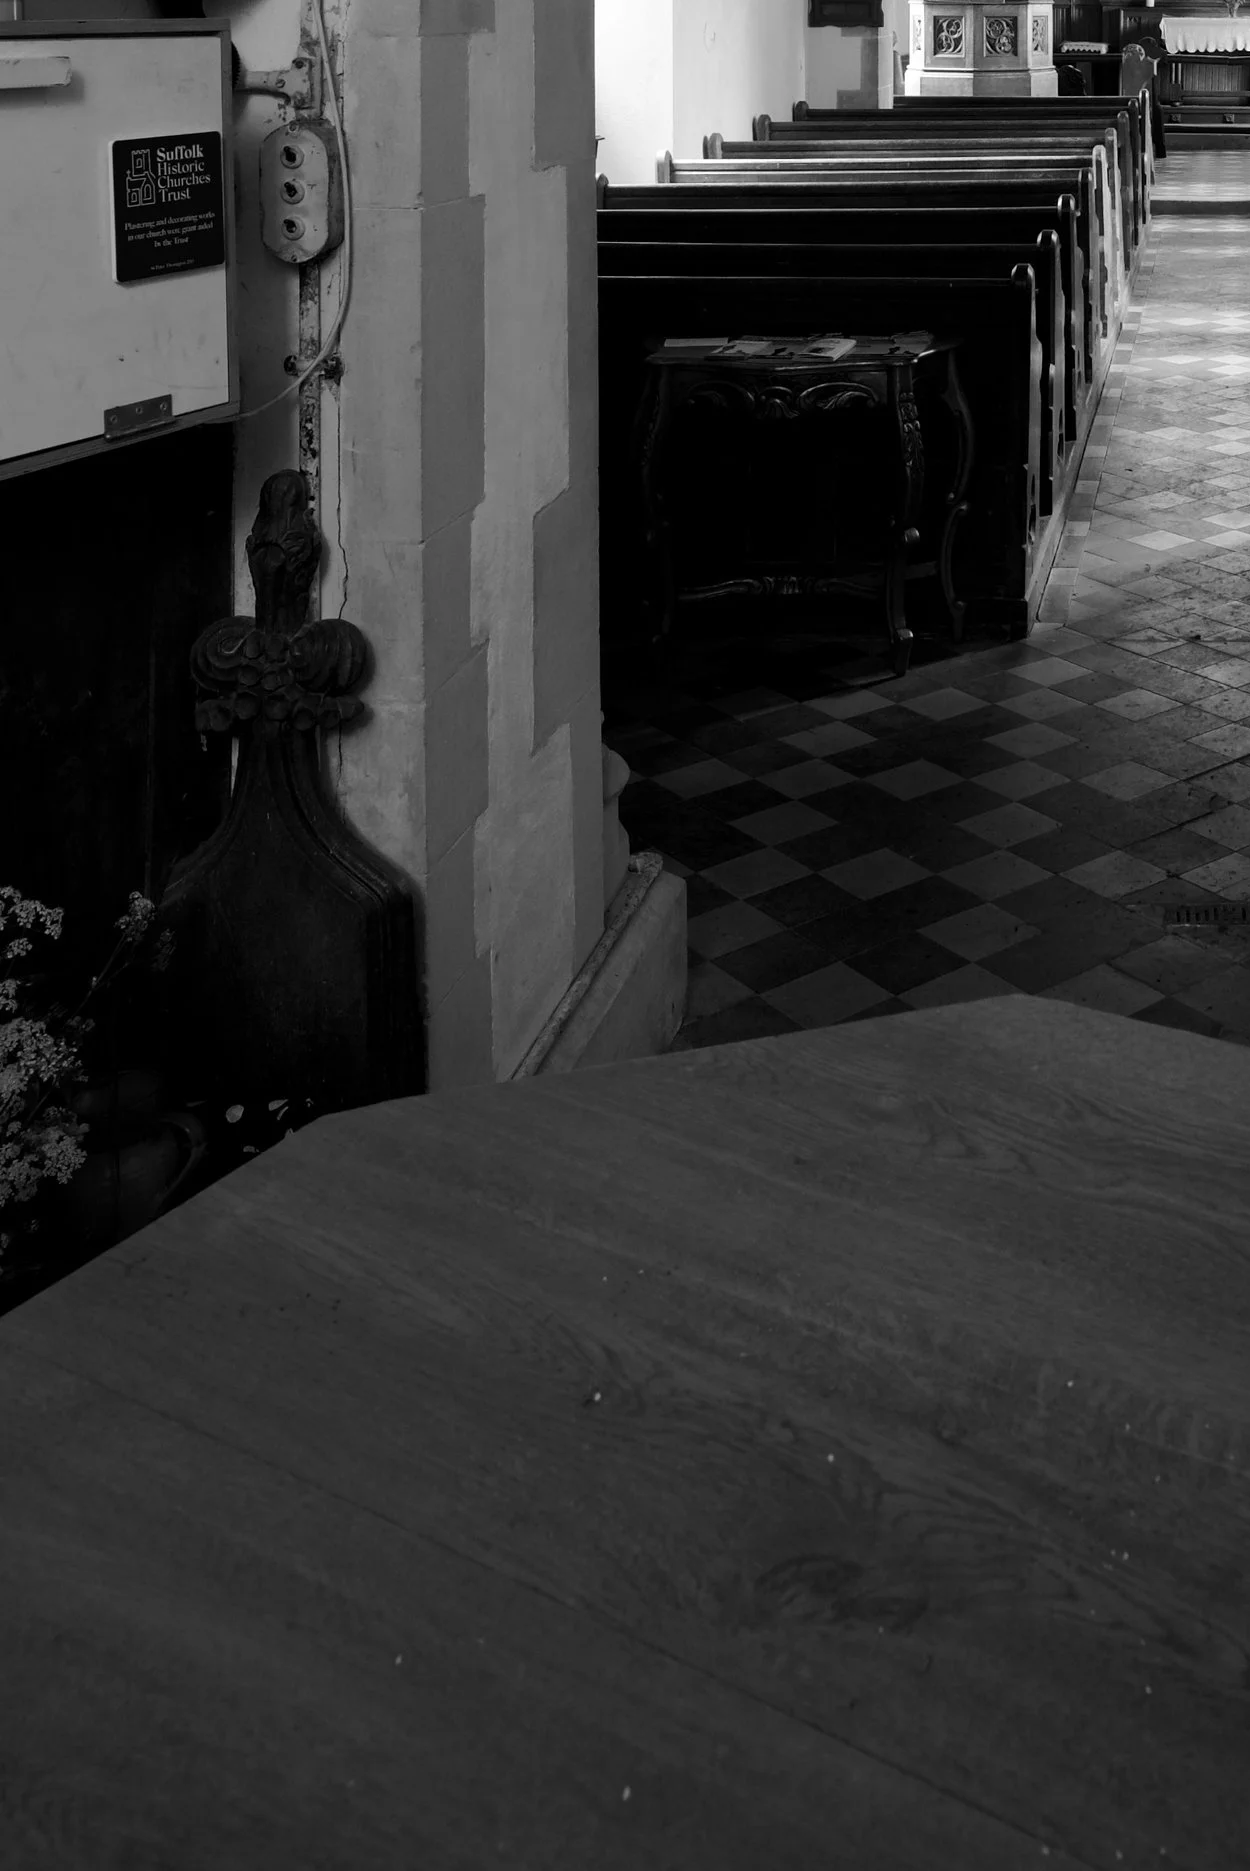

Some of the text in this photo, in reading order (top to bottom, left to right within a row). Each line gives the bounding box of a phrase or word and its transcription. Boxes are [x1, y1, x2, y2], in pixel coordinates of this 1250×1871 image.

[156, 144, 204, 162] Suffolk
[157, 161, 205, 176] Historic
[158, 173, 211, 189] Churches
[158, 188, 192, 203] Trust
[124, 212, 215, 231] Plastering and decorating works
[128, 221, 213, 241] in our church were grant aided
